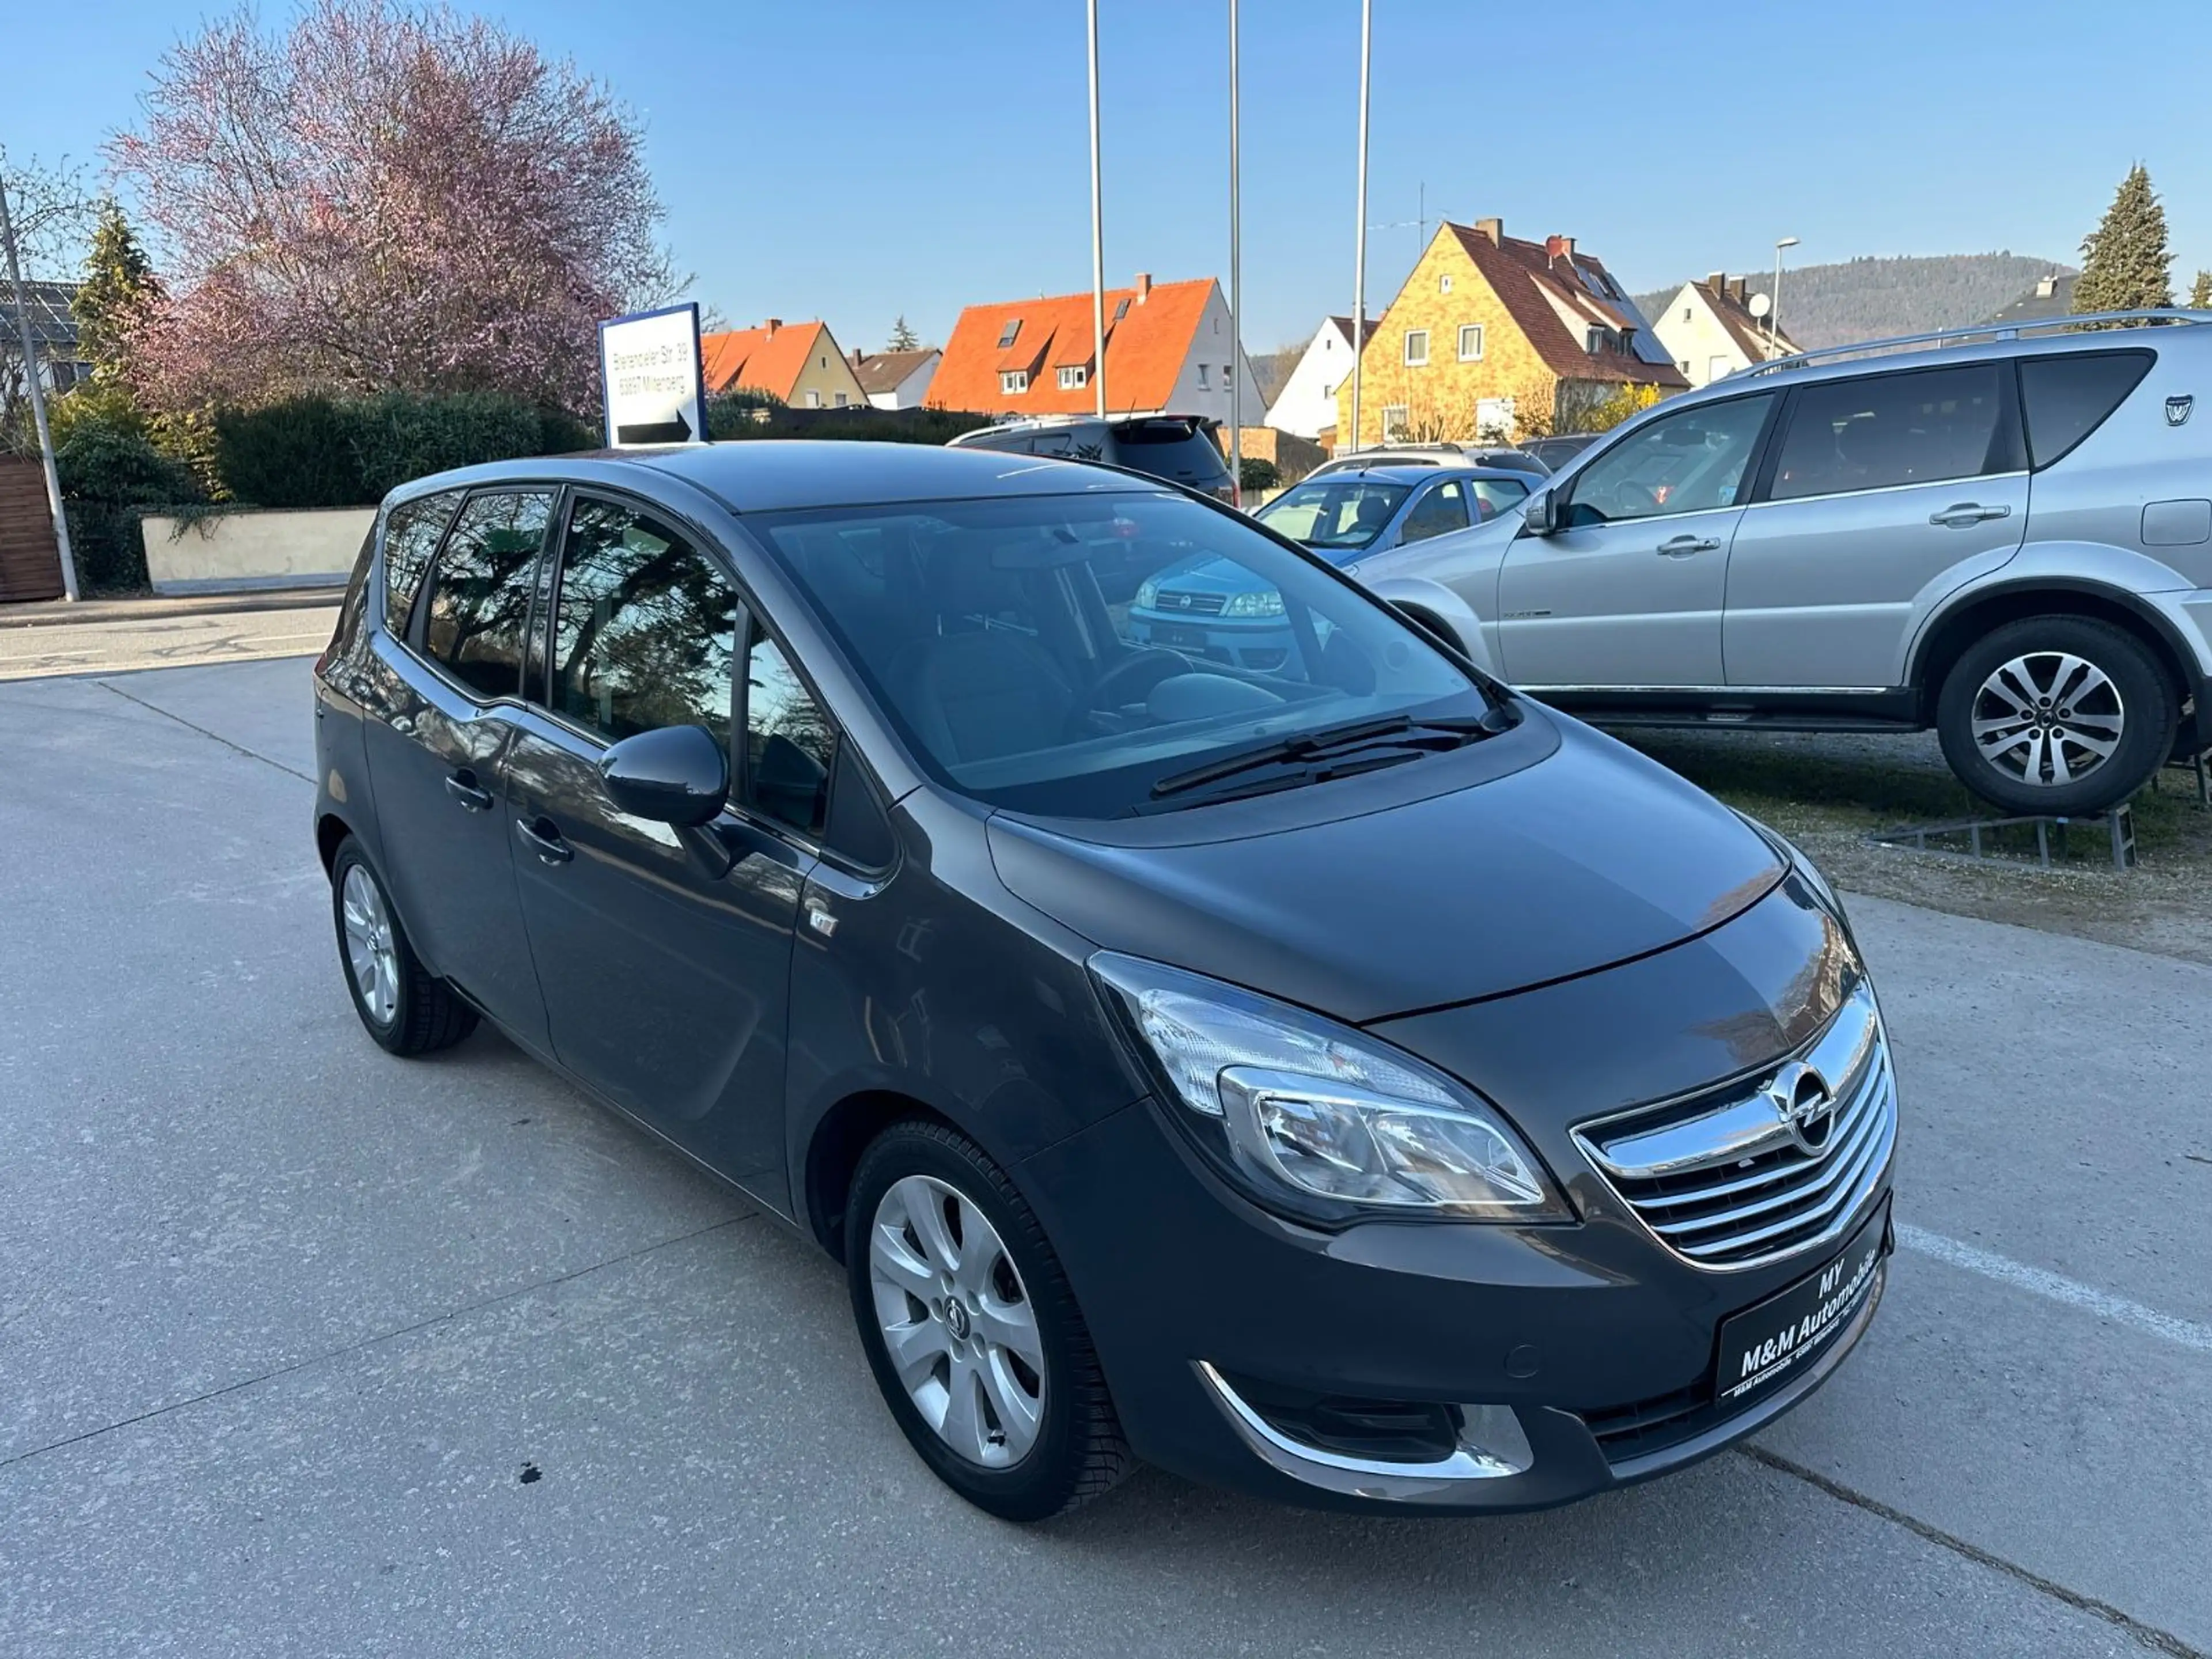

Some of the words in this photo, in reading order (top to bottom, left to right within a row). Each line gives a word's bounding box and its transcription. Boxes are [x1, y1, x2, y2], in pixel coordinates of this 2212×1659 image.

[1741, 1324, 1796, 1377] M&M
[1797, 1248, 1876, 1344] Automobile
[1818, 1257, 1845, 1298] MY
